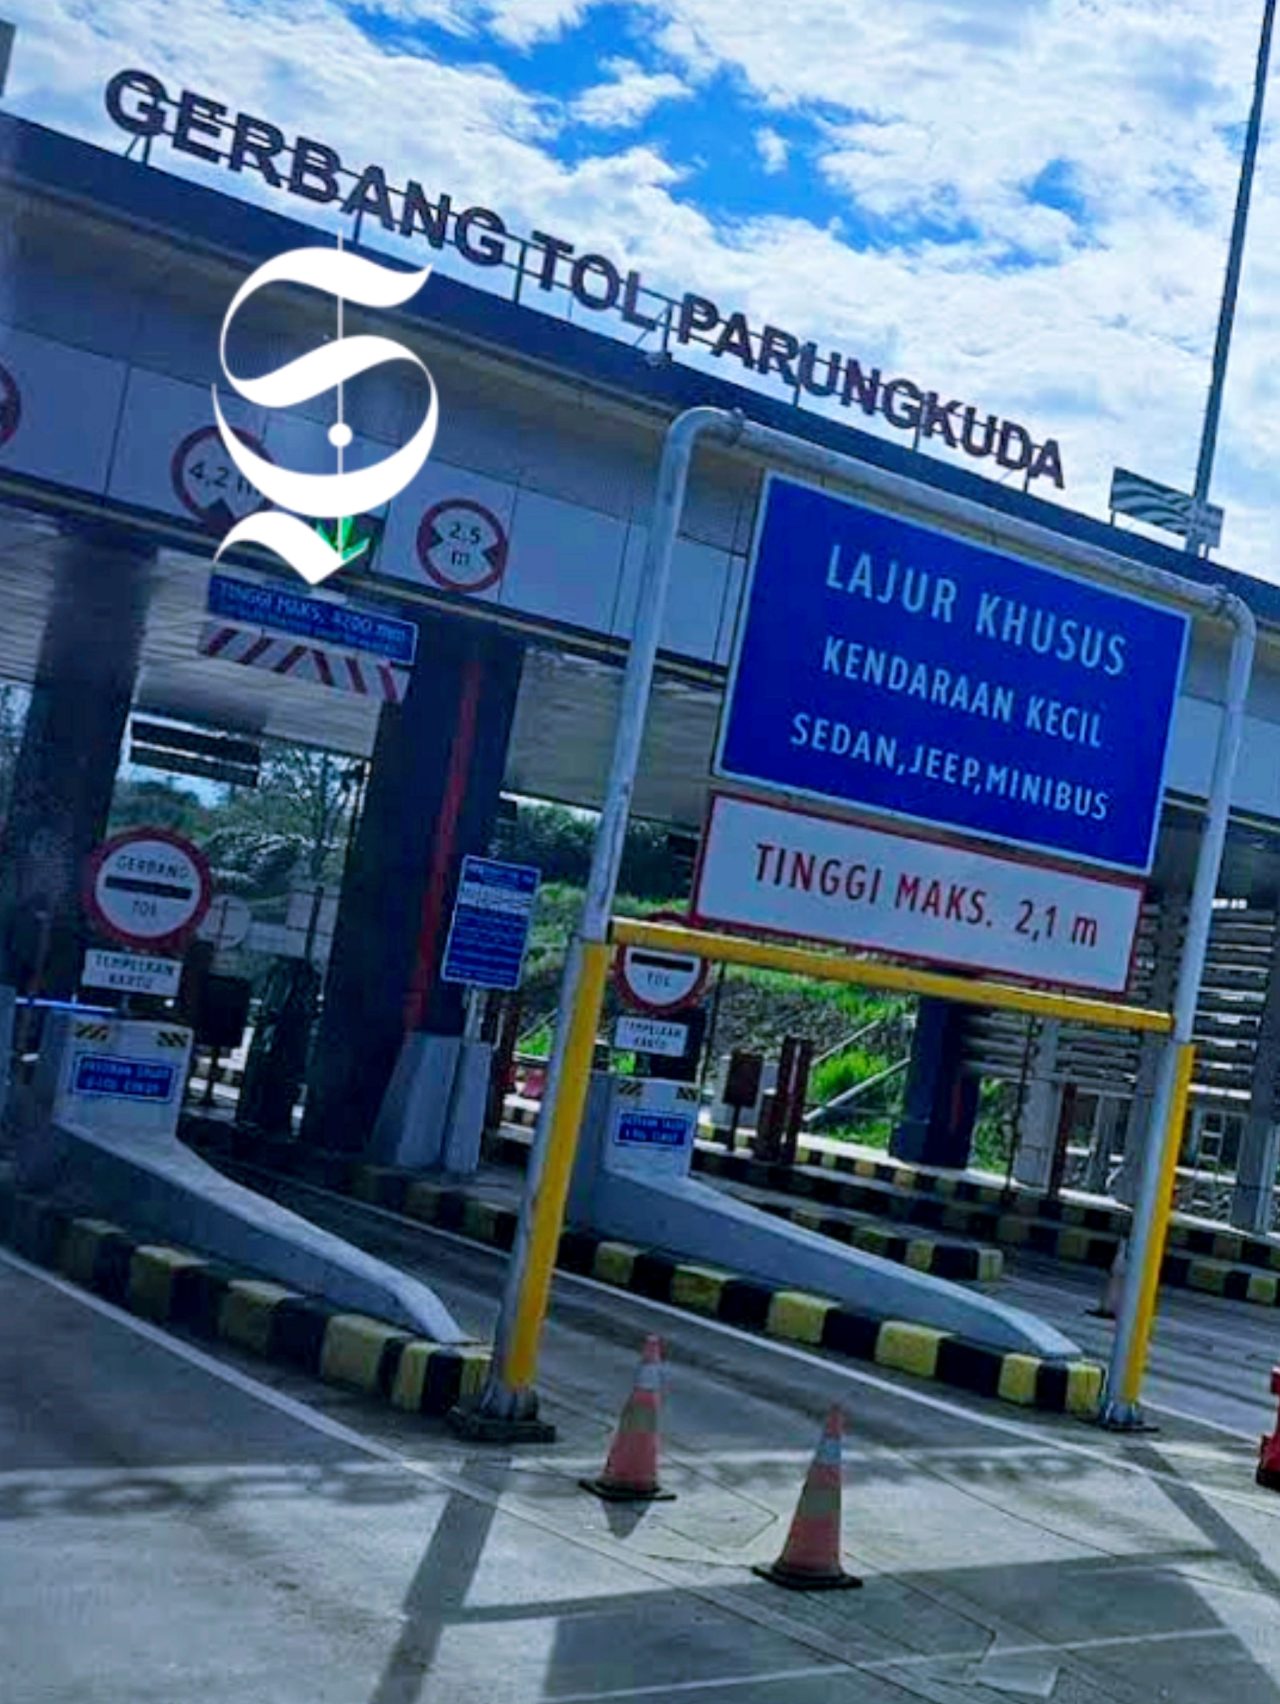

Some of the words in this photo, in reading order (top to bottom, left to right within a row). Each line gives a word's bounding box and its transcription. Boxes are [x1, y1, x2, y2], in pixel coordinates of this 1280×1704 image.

[104, 68, 508, 268] GERBANG
[531, 229, 657, 331] TOL
[677, 291, 1066, 491] PARUNGKUDA
[451, 549, 471, 566] m
[825, 543, 958, 624] LAJUR
[975, 592, 1126, 676] KHUSUS
[822, 635, 1015, 724] KENDARAAN
[1025, 695, 1102, 749] KECIL
[116, 855, 189, 879] GERBANG
[755, 843, 882, 906] TINGGI
[895, 871, 993, 929] MAKS.
[1014, 899, 1057, 943] 2,1
[1072, 914, 1098, 948] m
